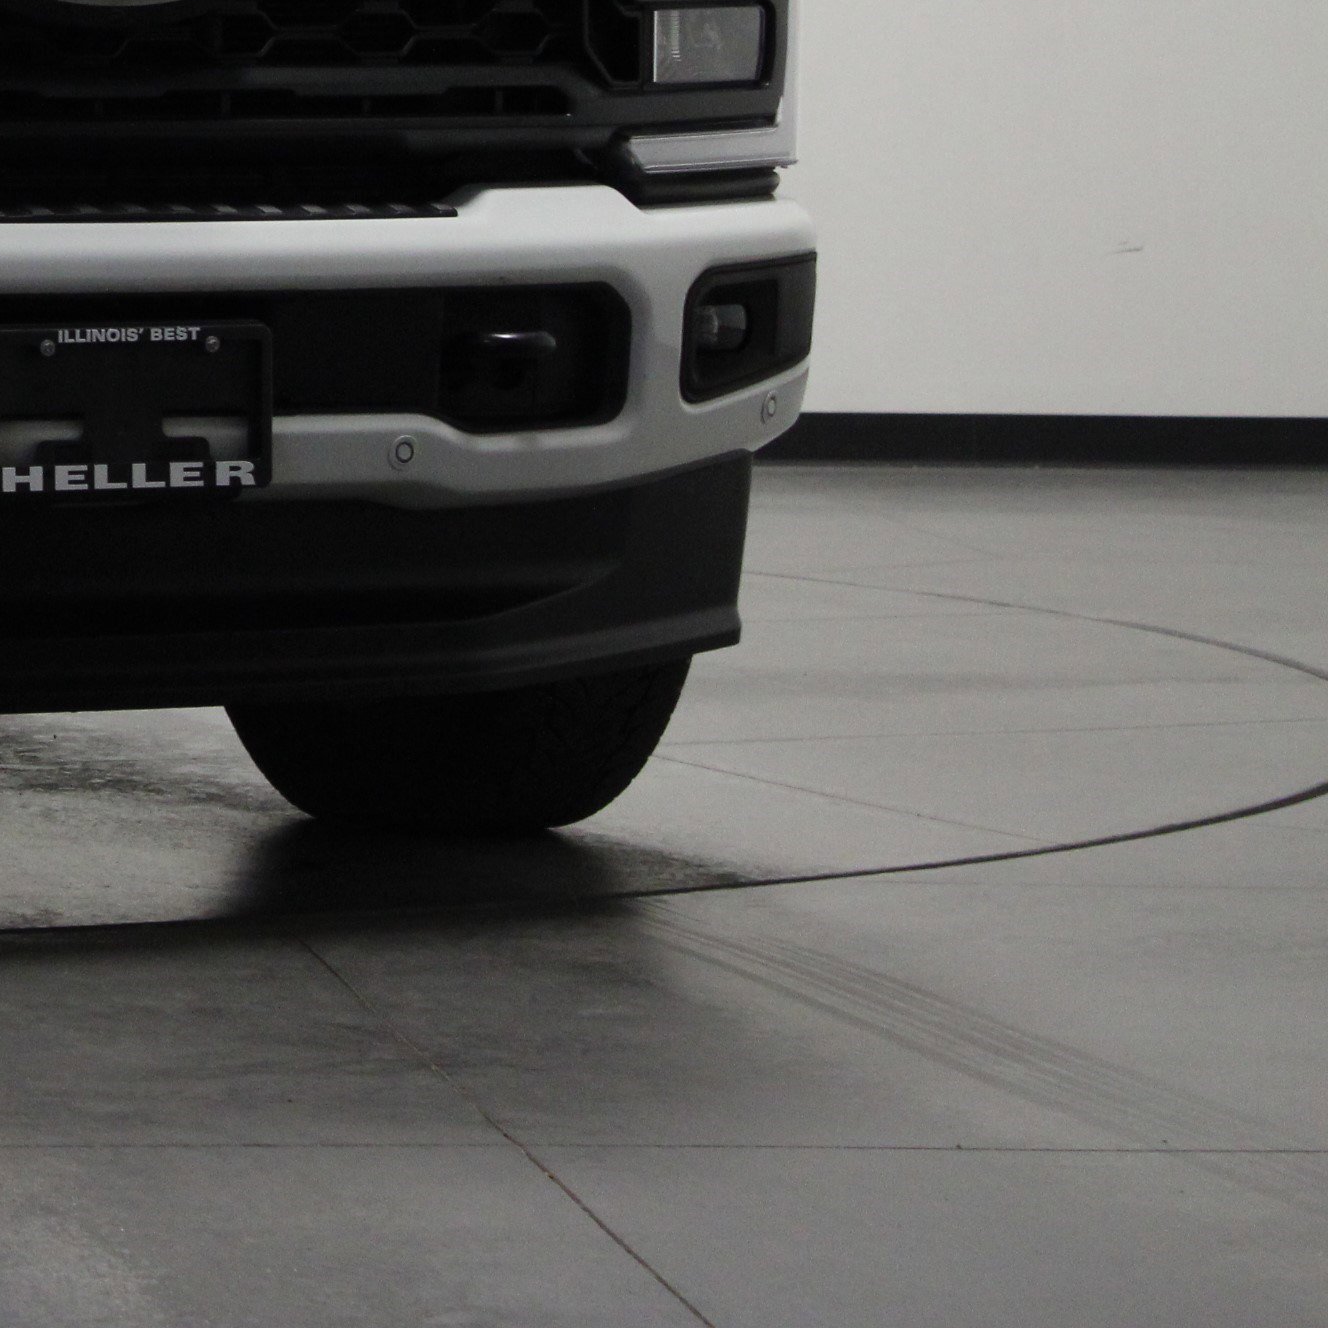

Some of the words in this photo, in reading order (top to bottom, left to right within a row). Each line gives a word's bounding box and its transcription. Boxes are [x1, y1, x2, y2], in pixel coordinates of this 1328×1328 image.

[58, 328, 143, 343] ILLINOIS'
[150, 326, 201, 341] BEST
[2, 460, 256, 492] HELLER
